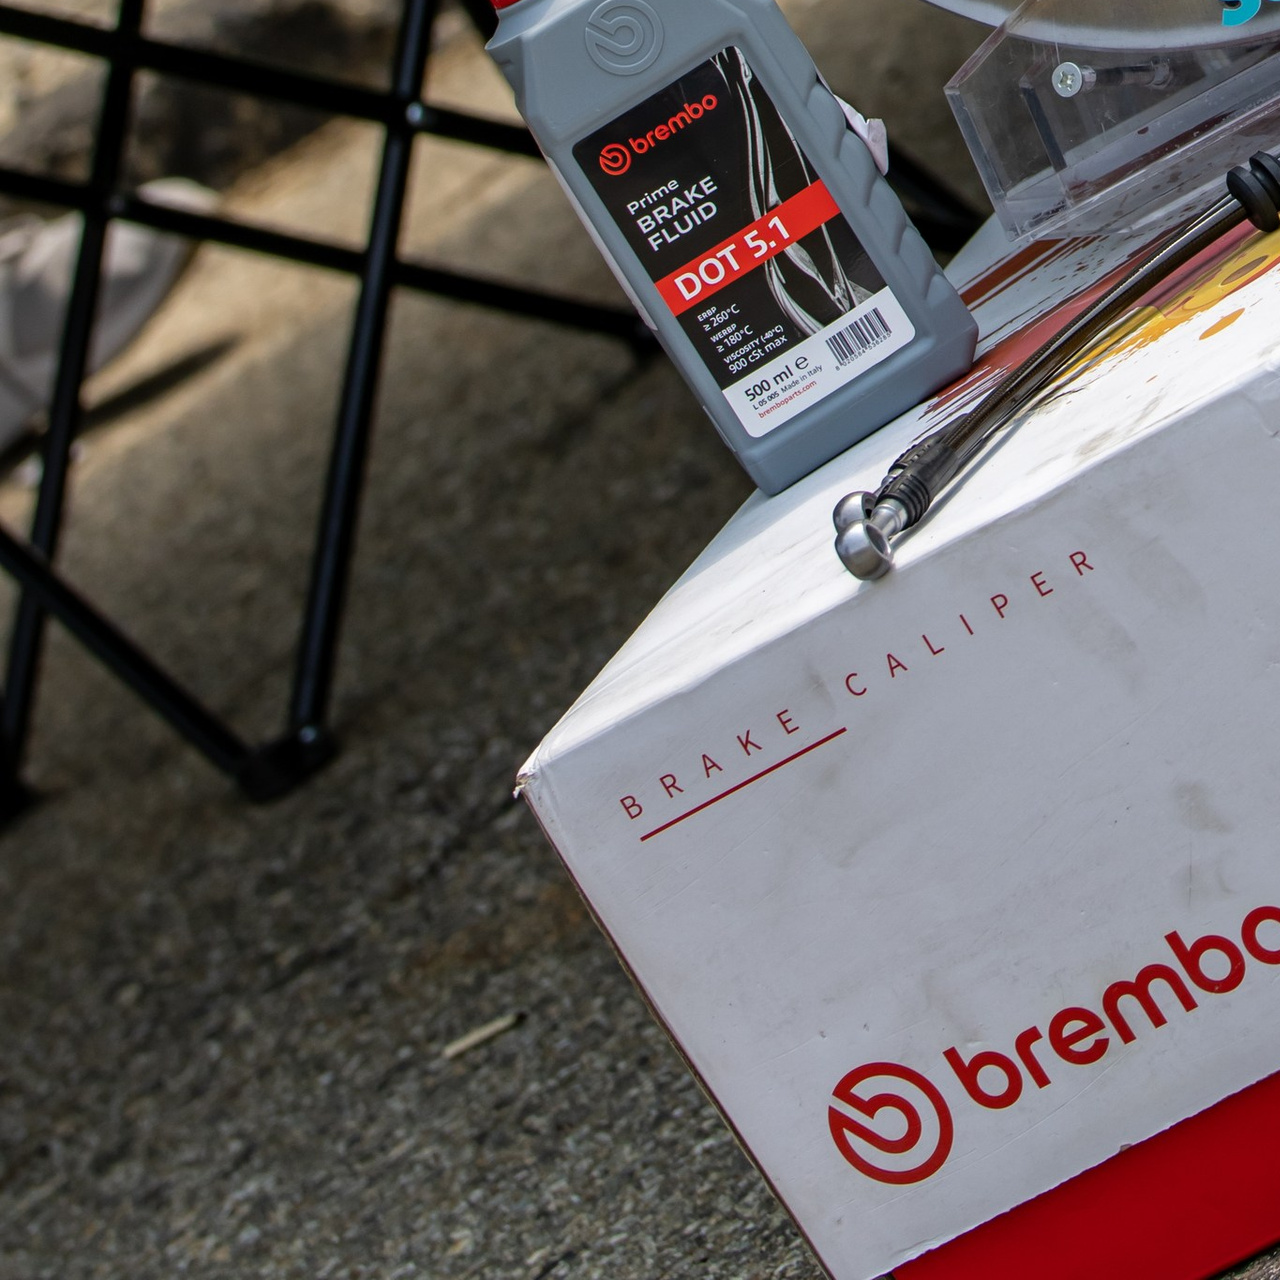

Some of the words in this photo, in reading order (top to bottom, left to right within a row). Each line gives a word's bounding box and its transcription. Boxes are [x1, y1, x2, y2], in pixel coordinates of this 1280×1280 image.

[628, 94, 718, 154] brembo
[626, 179, 679, 215] Prime
[636, 176, 718, 234] BRAKE
[647, 201, 718, 252] FLUID
[674, 244, 740, 301] DOT
[743, 216, 790, 258] 5.1
[697, 306, 717, 322] ERBP
[710, 303, 740, 328] 260°C
[710, 323, 737, 343] WERBP
[723, 325, 753, 348] 180°C
[723, 339, 761, 365] VISCOSITY
[728, 360, 747, 374] 900
[748, 348, 765, 364] cSt
[764, 336, 788, 353] max
[744, 379, 771, 402] 500
[772, 365, 793, 386] ml
[752, 403, 758, 411] L
[758, 398, 768, 408] 05
[767, 391, 780, 402] 005
[781, 379, 800, 394] Made
[799, 374, 808, 383] in
[807, 364, 823, 379] Italy
[758, 380, 817, 419] bremboparts.com
[619, 709, 800, 820] BRAKE
[845, 549, 1094, 696] CALIPER
